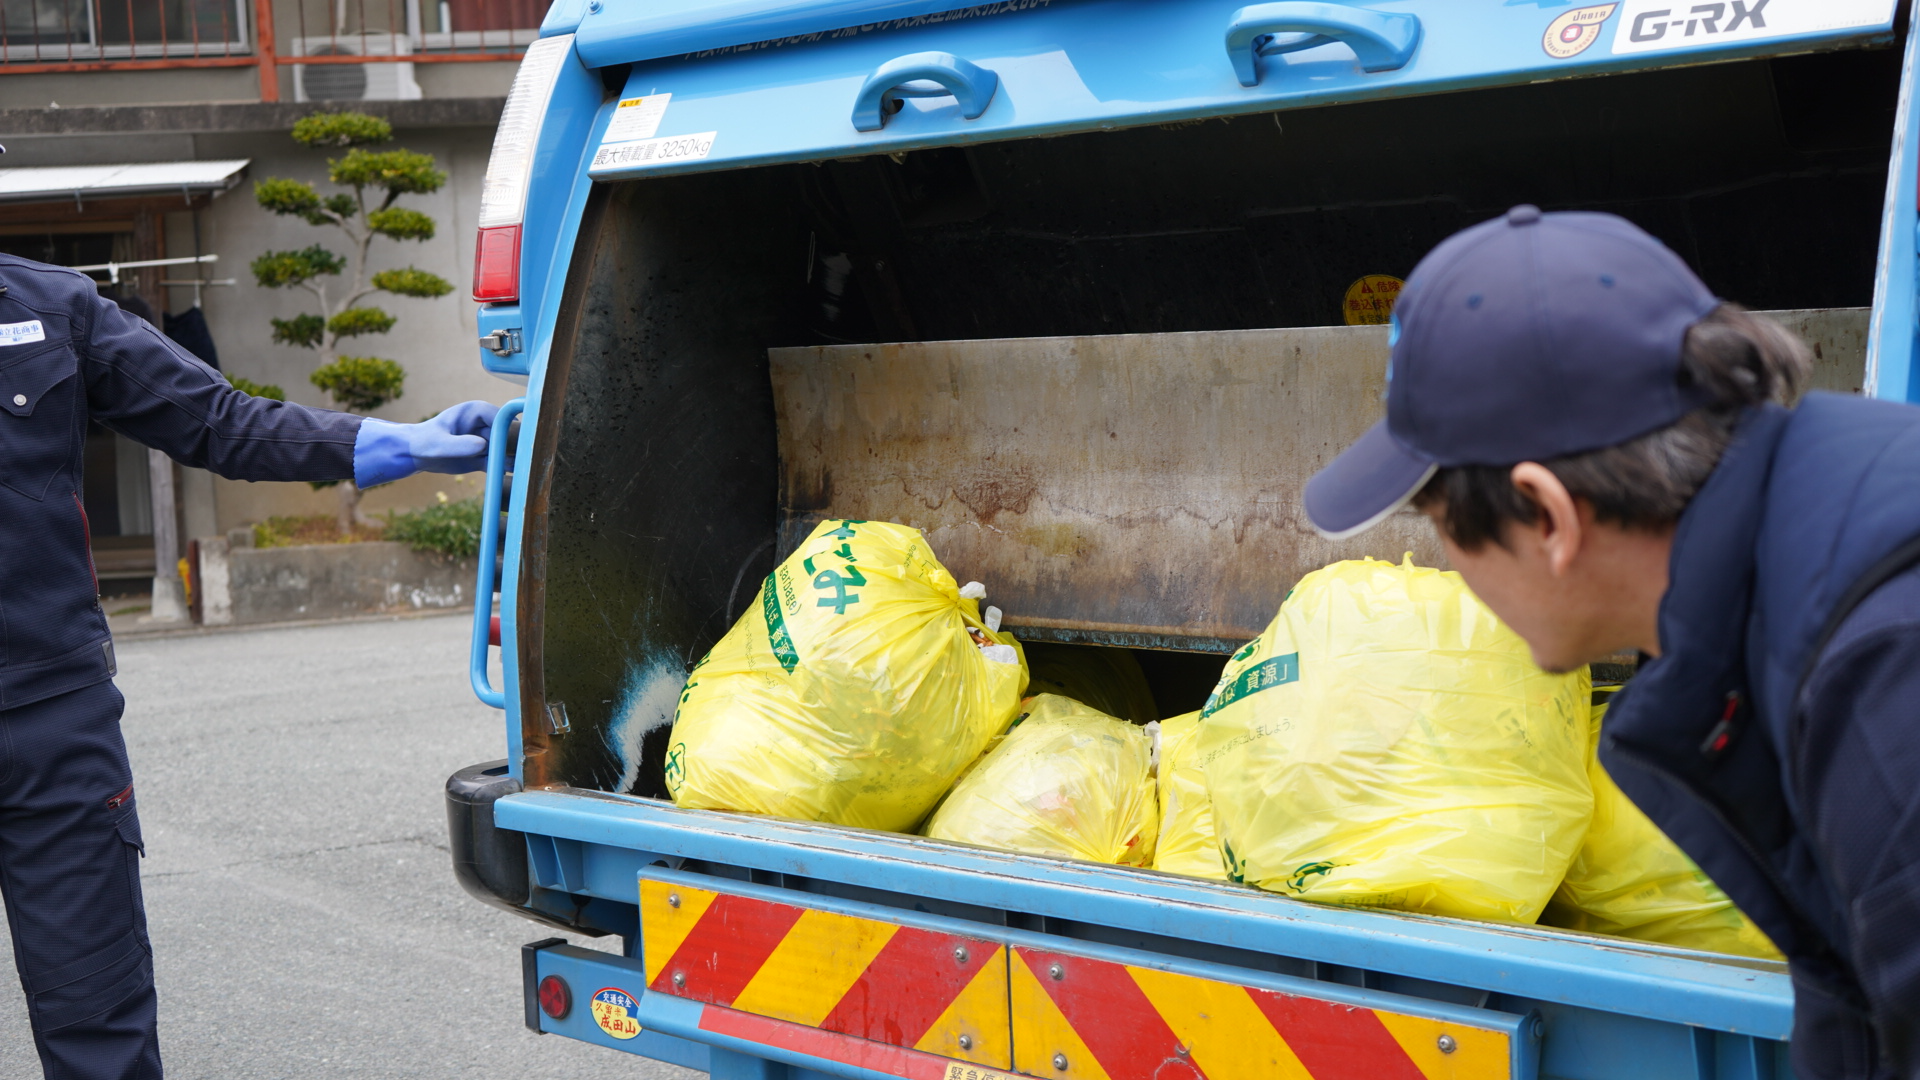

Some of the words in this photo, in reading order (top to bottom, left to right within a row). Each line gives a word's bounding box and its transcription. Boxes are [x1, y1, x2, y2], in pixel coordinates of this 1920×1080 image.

[1629, 0, 1771, 43] G-RX
[593, 142, 658, 166] 最大積載量
[658, 138, 712, 160] 3250kg
[1376, 280, 1400, 293] 危険
[1246, 662, 1289, 693] 資源」
[595, 1002, 622, 1018] 久留米
[602, 991, 632, 1008] 交通安全
[600, 1013, 636, 1035] 成田山
